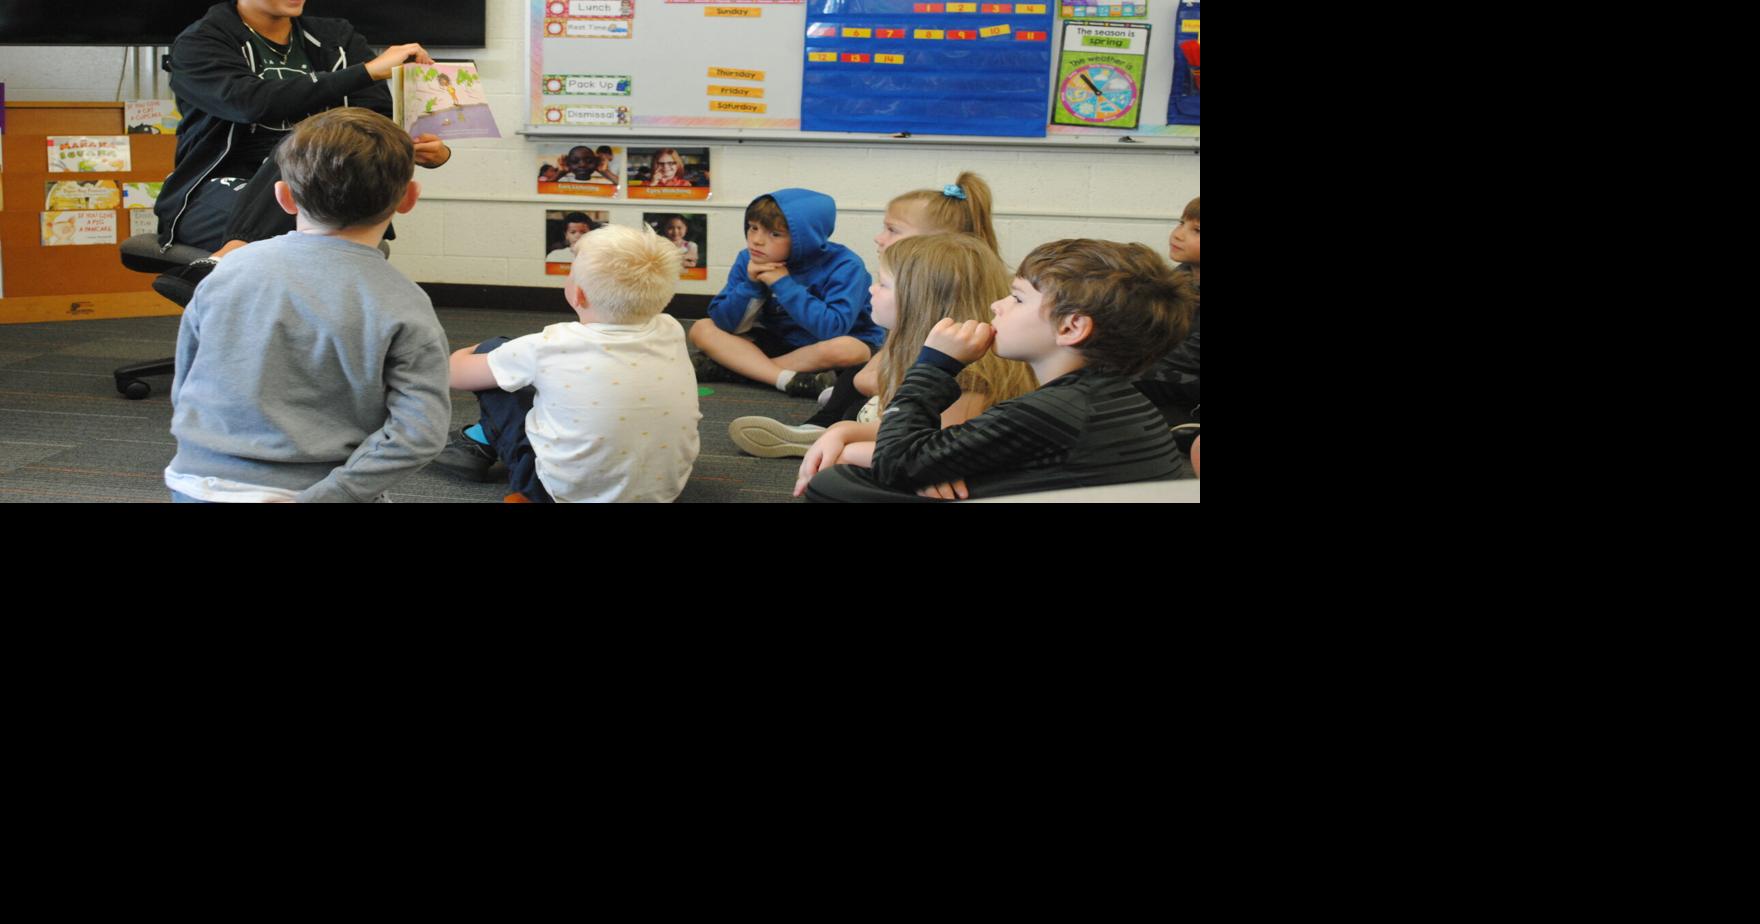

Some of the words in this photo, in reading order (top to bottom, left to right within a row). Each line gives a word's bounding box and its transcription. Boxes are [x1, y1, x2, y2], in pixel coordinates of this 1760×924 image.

[578, 3, 612, 12] Lunch
[926, 4, 931, 12] 1
[992, 4, 999, 13] 3
[716, 8, 749, 16] Sunday
[886, 30, 894, 38] 7
[958, 31, 965, 39] 9
[990, 27, 1001, 35] 10
[1077, 27, 1093, 36] The
[1127, 30, 1136, 38] is
[1026, 32, 1035, 40] 11
[1089, 37, 1124, 47] spring
[817, 53, 828, 61] 12
[884, 55, 895, 63] 14
[1087, 55, 1126, 65] weather
[716, 68, 756, 79] Thursday
[568, 80, 595, 88] Pack
[600, 80, 614, 90] Up
[720, 87, 749, 96] Friday
[717, 102, 758, 112] Saturday
[567, 110, 614, 118] Dismissal
